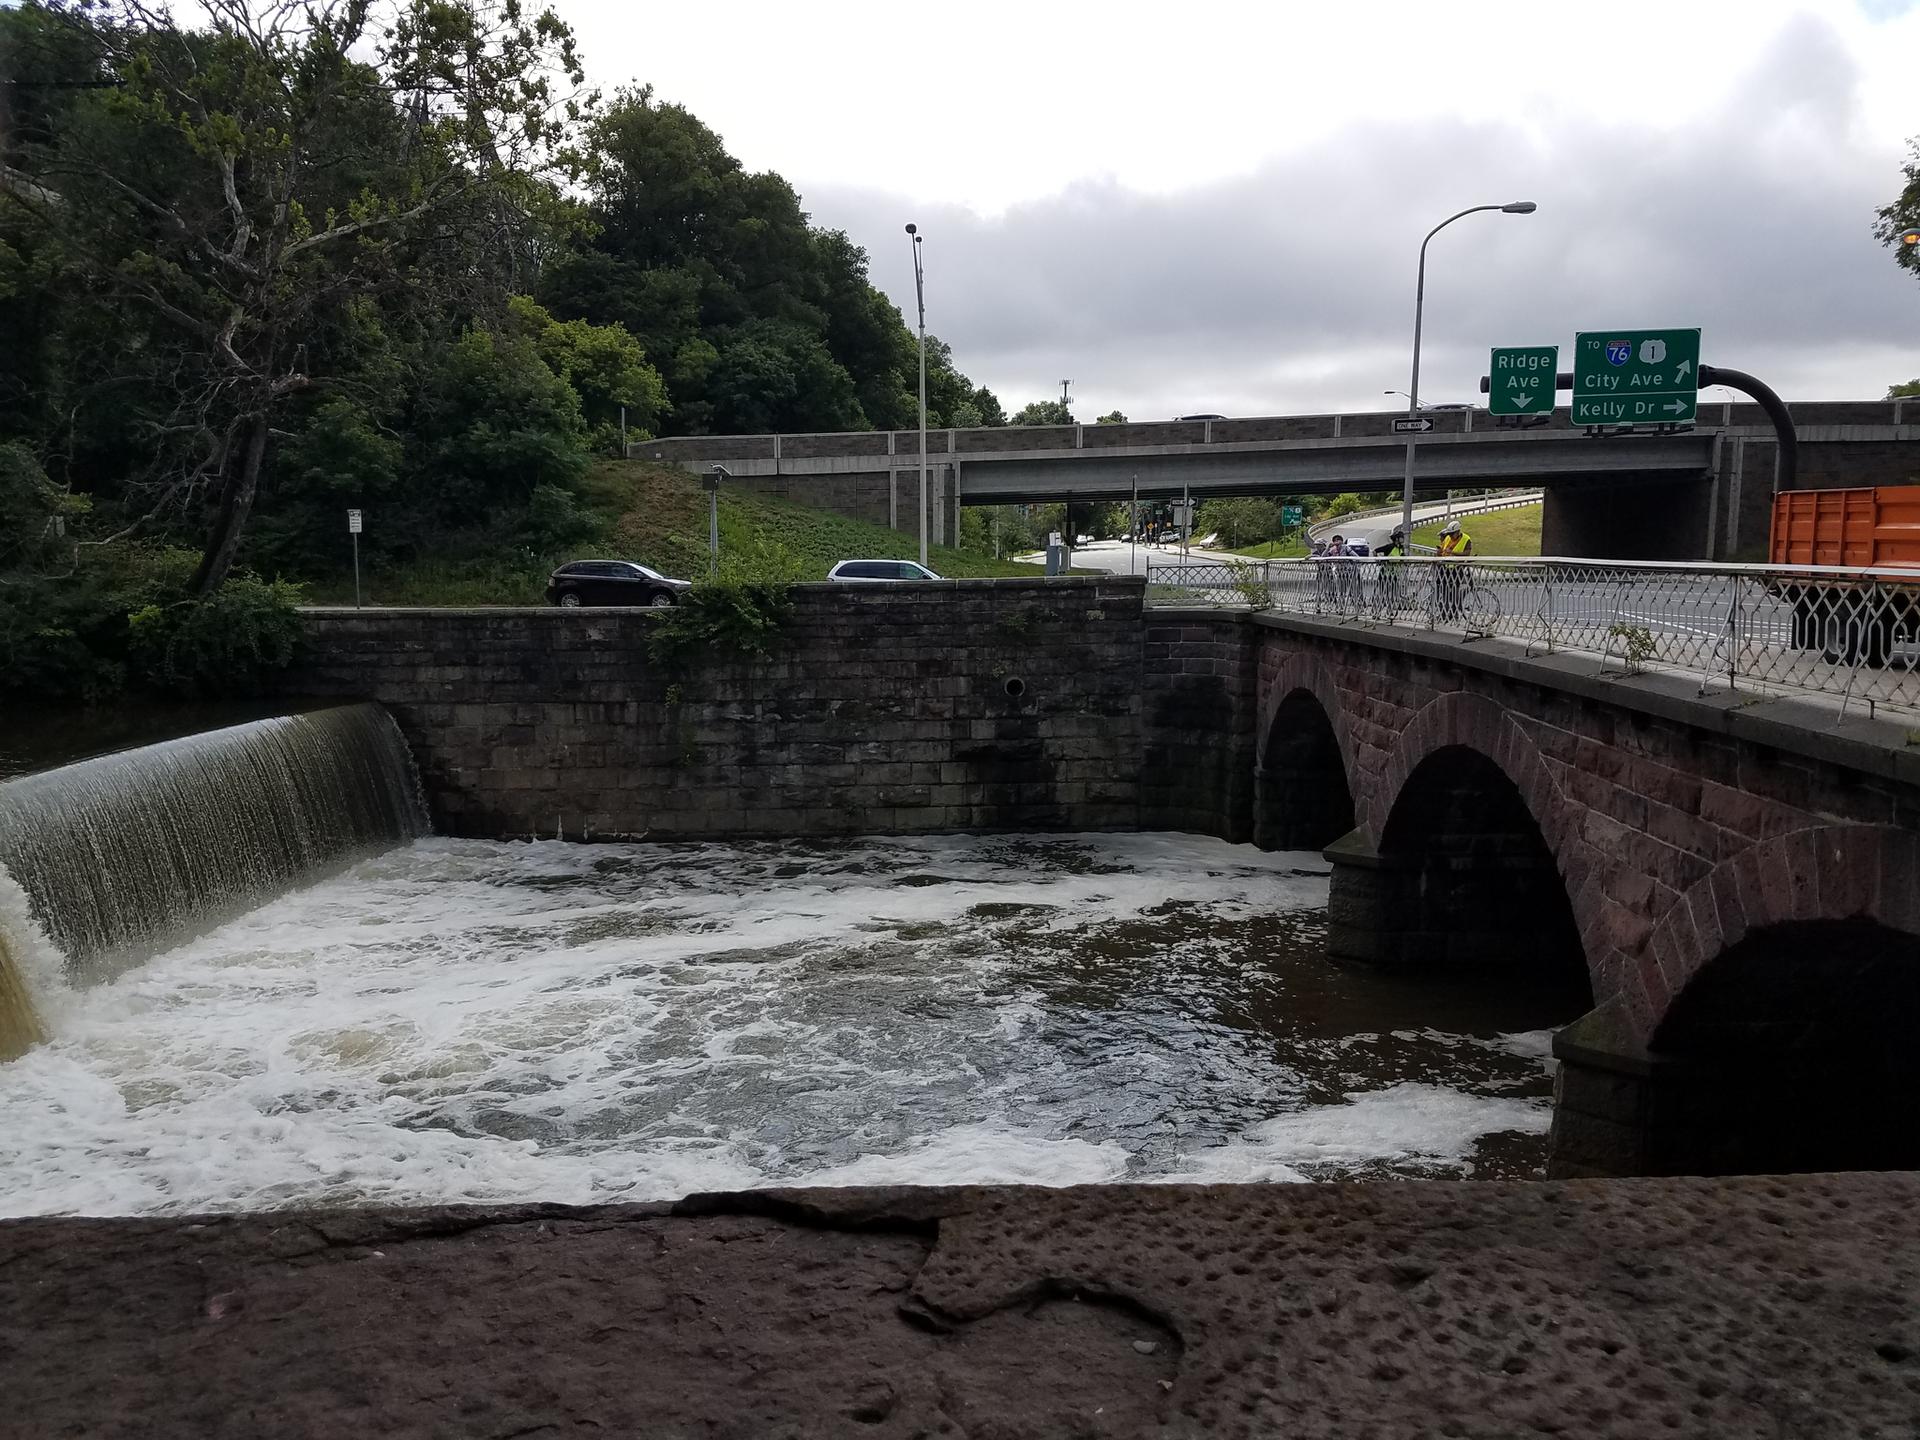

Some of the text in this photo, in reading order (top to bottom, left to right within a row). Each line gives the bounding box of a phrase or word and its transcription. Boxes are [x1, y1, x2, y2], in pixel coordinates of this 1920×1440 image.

[1586, 341, 1656, 361] TO 76 1
[1498, 354, 1550, 370] Ridge
[1507, 376, 1540, 388] Ave
[1585, 373, 1663, 390] City Ave
[1580, 401, 1655, 418] Kelly Dr
